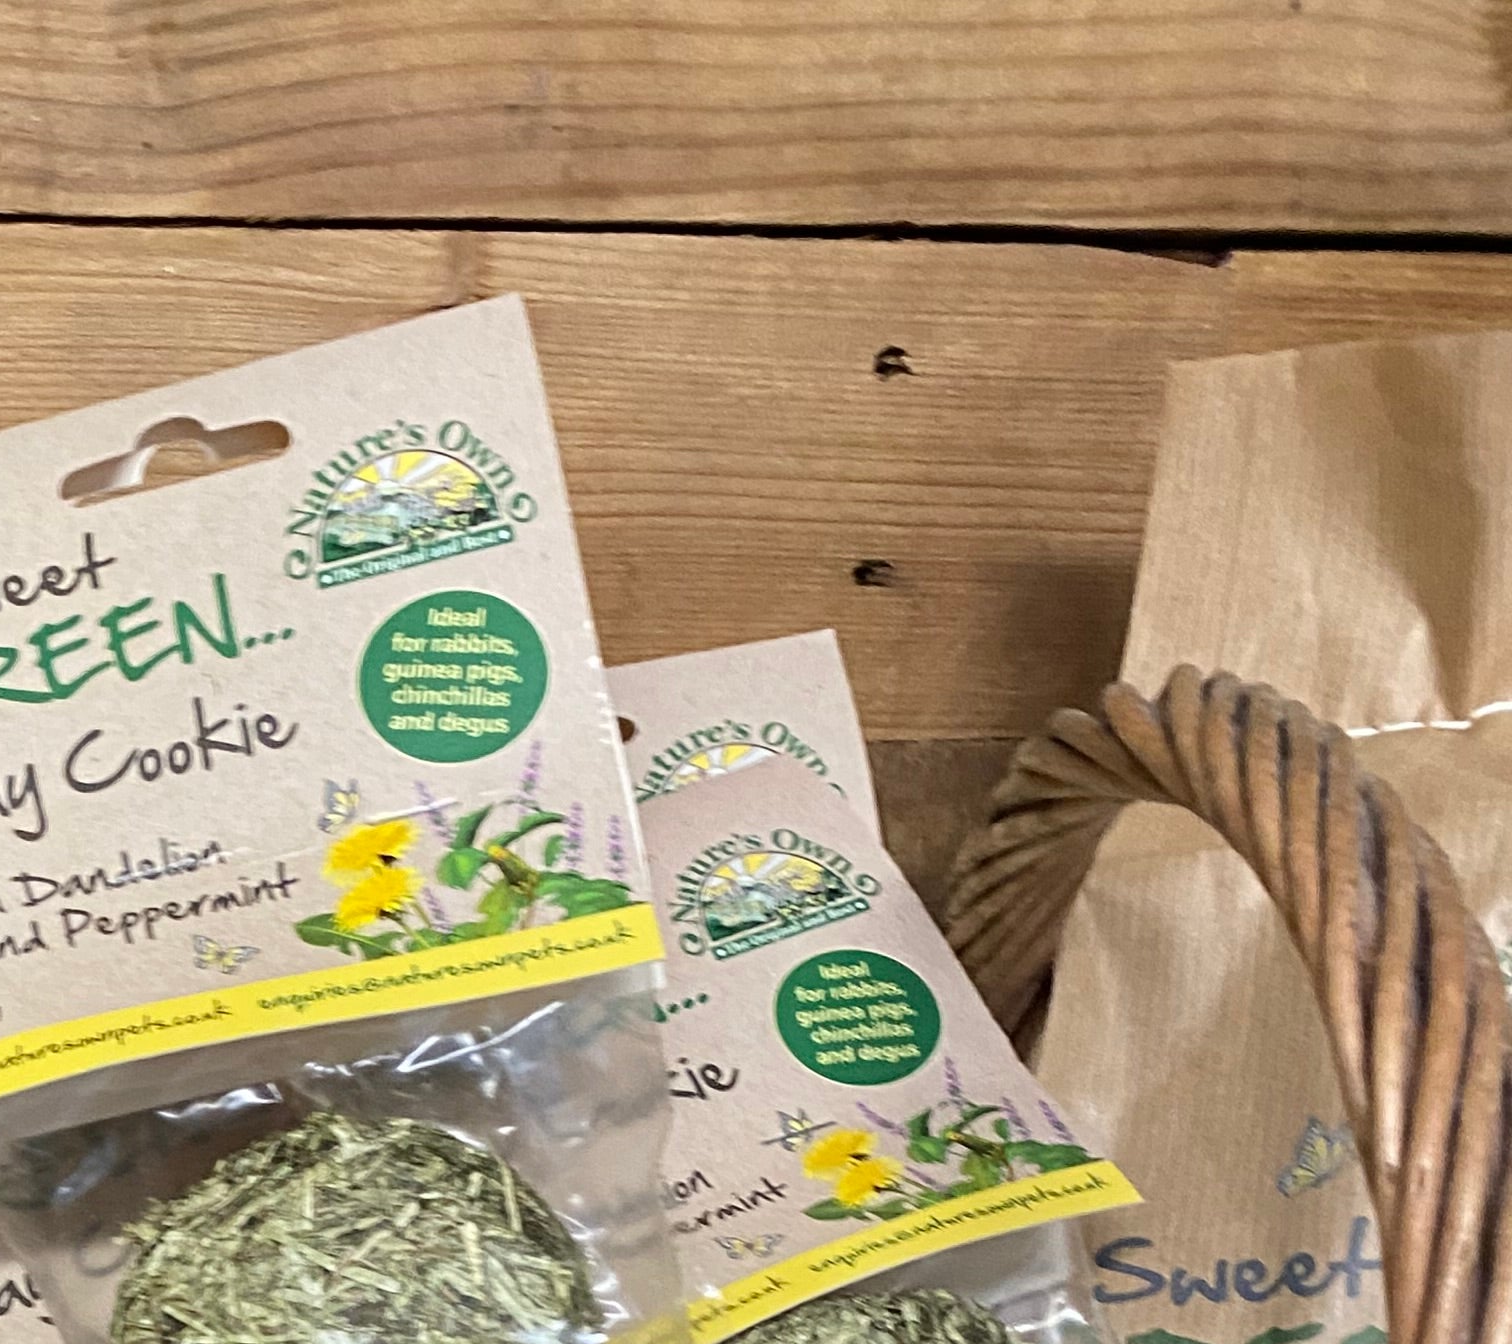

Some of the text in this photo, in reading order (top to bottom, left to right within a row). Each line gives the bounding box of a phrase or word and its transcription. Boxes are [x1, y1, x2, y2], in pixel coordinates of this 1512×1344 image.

[285, 419, 516, 537] Nature's Own
[427, 607, 487, 627] Ideal
[391, 632, 519, 657] for rabbits,
[382, 659, 524, 685] guinea pigs,
[391, 684, 511, 707] chinchillas
[388, 711, 510, 737] and degus
[65, 697, 299, 793] Cookie
[635, 719, 829, 803] Nature's Own
[10, 838, 228, 907] Dandelion
[668, 828, 853, 923] Nature's Own
[60, 861, 299, 947] Peppermint
[818, 960, 871, 980] Ideal
[793, 980, 908, 1003] for rabbits,
[795, 1000, 919, 1028] guinea pigs,
[810, 1021, 915, 1044] chinchillas
[815, 1043, 921, 1065] and degus
[673, 1176, 788, 1233] ermint
[1094, 1216, 1383, 1306] Sweet
